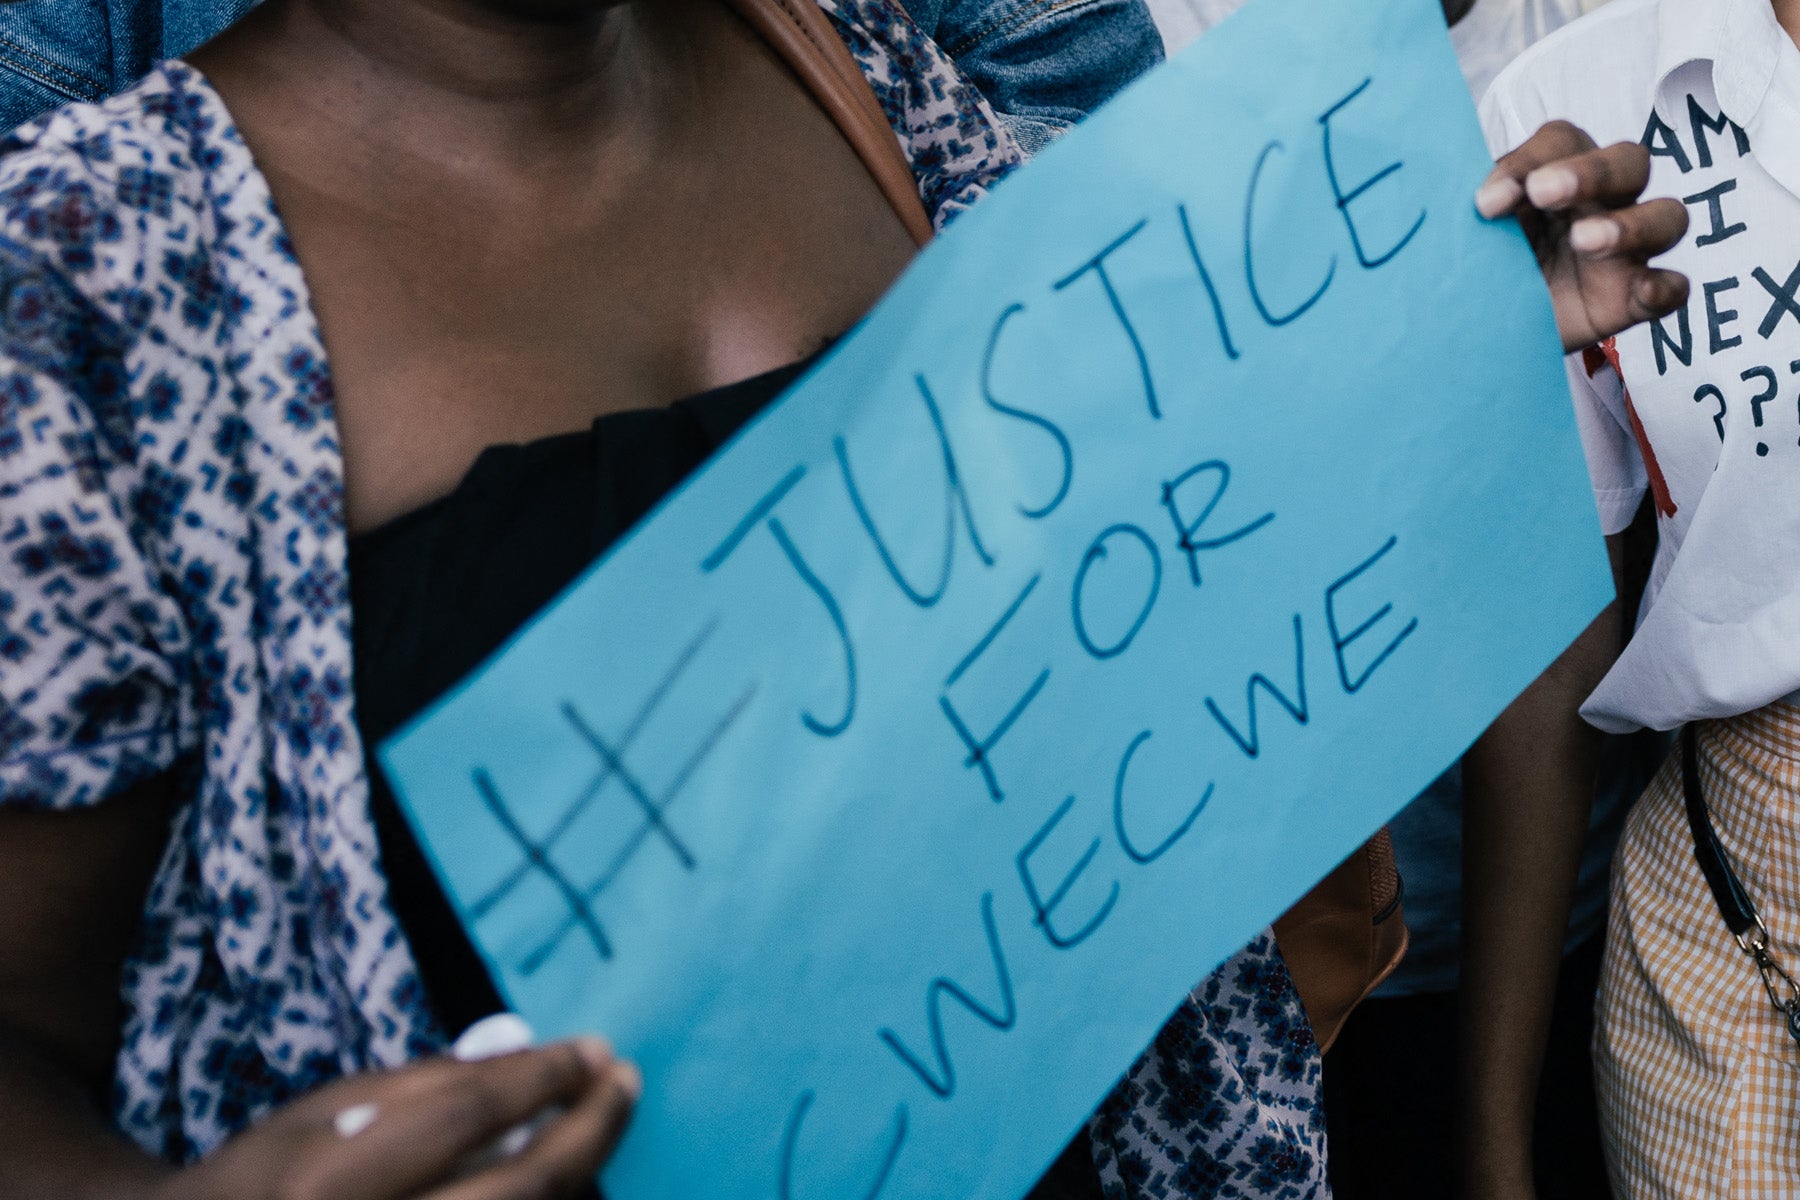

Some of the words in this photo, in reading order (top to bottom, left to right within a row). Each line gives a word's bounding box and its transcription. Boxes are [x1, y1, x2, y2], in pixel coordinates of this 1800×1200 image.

[1639, 93, 1751, 174] AM
[1683, 178, 1747, 248] I
[940, 459, 1277, 802] FOR
